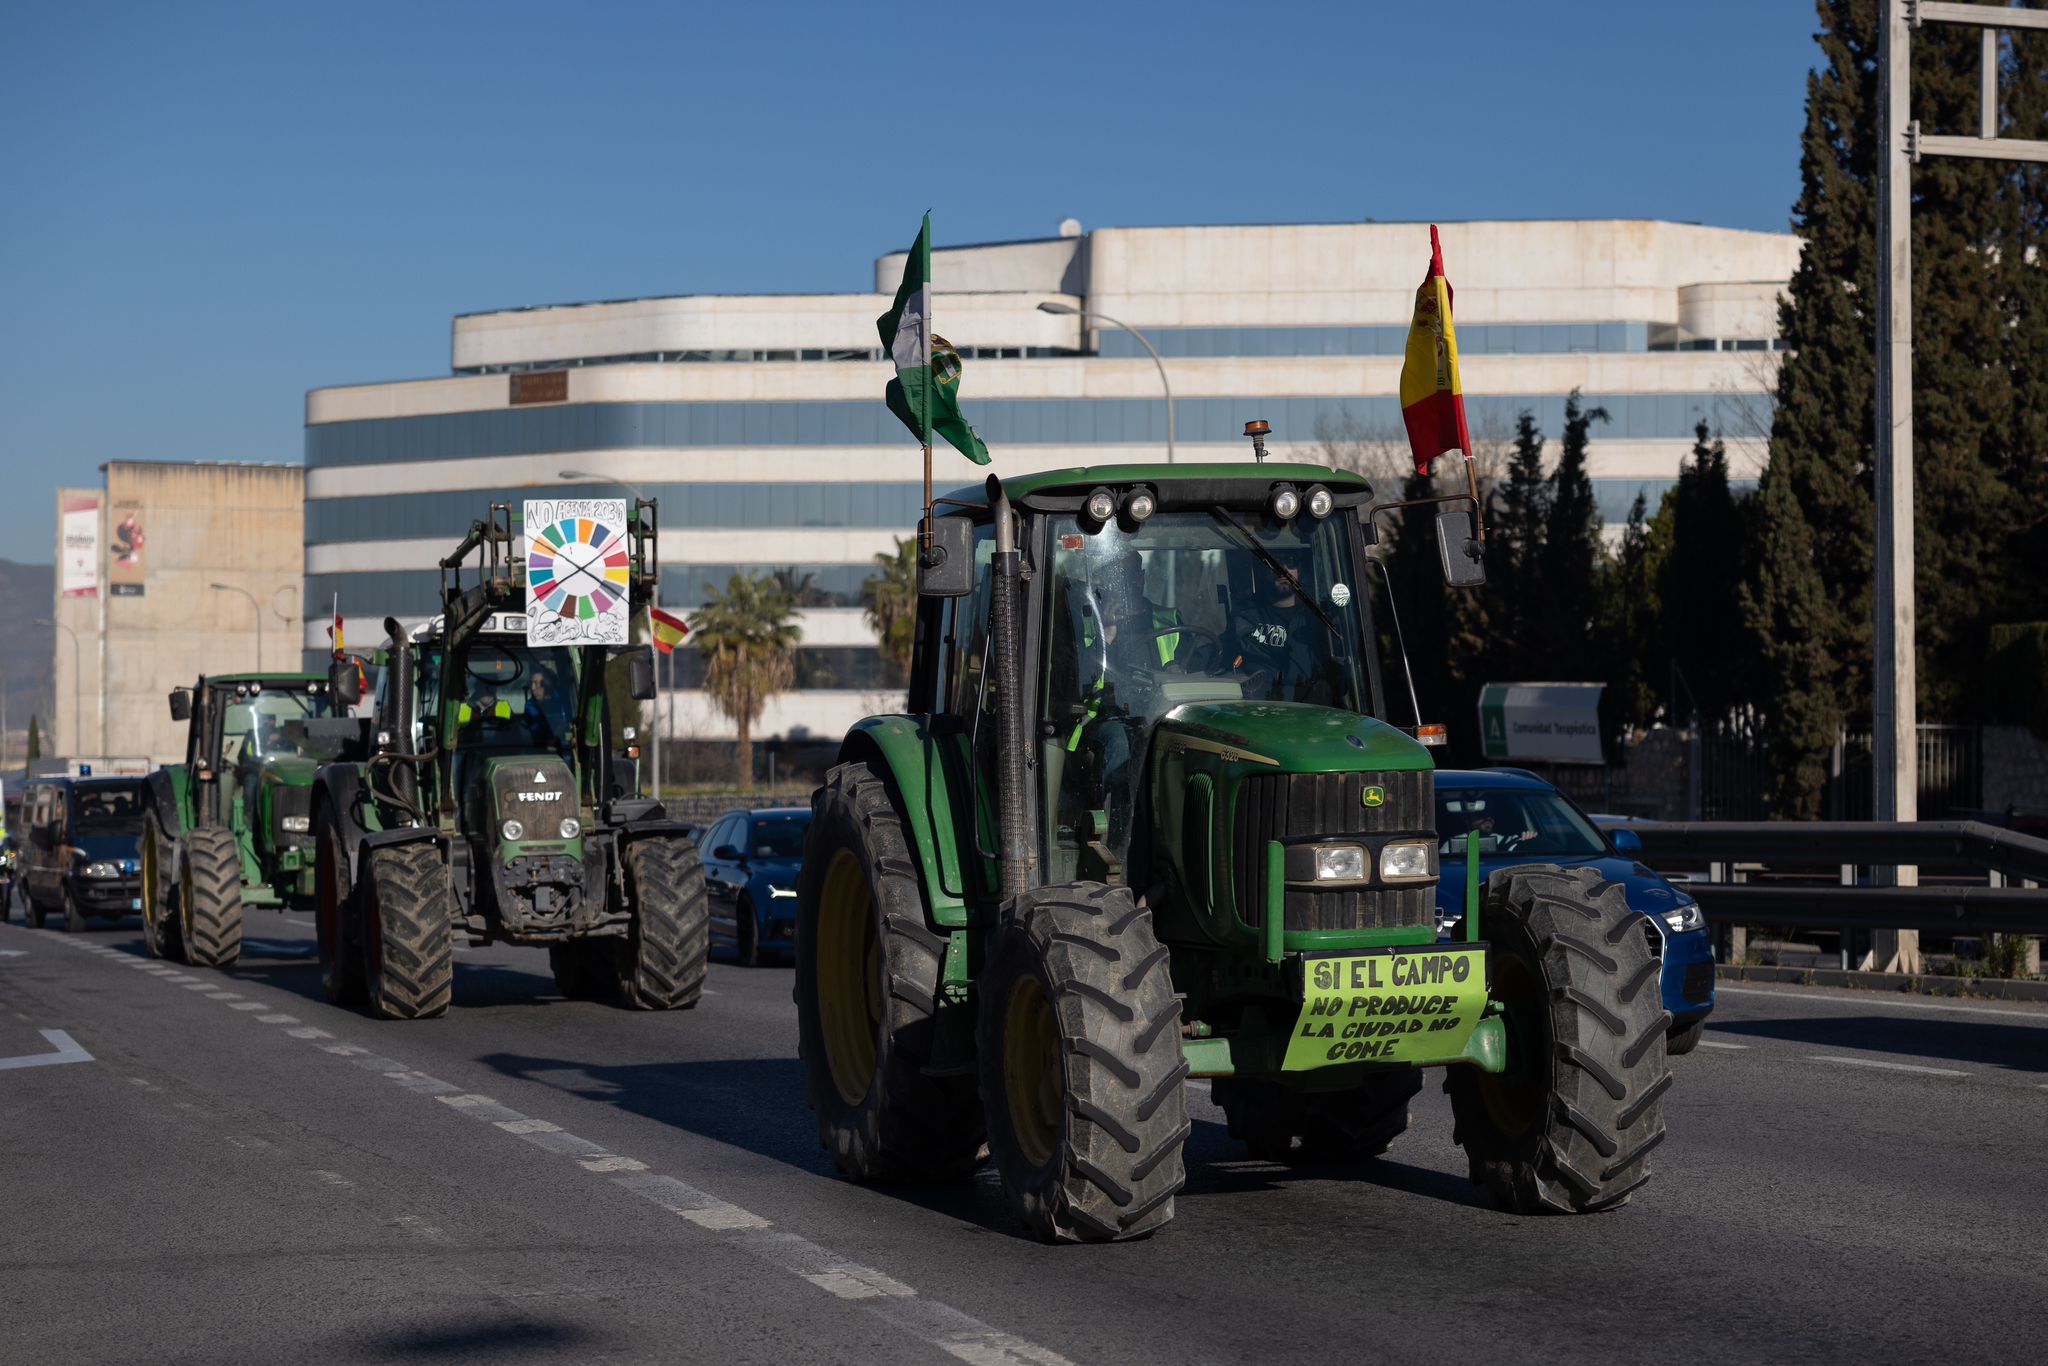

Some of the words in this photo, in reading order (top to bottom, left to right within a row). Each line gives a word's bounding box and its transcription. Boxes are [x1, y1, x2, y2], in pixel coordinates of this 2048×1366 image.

[526, 501, 554, 528] NO
[594, 501, 626, 528] 2030
[518, 792, 562, 801] FENDT
[1313, 961, 1340, 990] SI
[1351, 959, 1383, 989] EL
[1391, 955, 1470, 987] CAMPO
[1310, 997, 1343, 1016] NO
[1347, 995, 1459, 1017] PRODUCE
[1300, 1023, 1335, 1038] LA
[1341, 1019, 1423, 1039] CIUDAD
[1427, 1017, 1461, 1033] NO
[1326, 1039, 1400, 1061] COME
